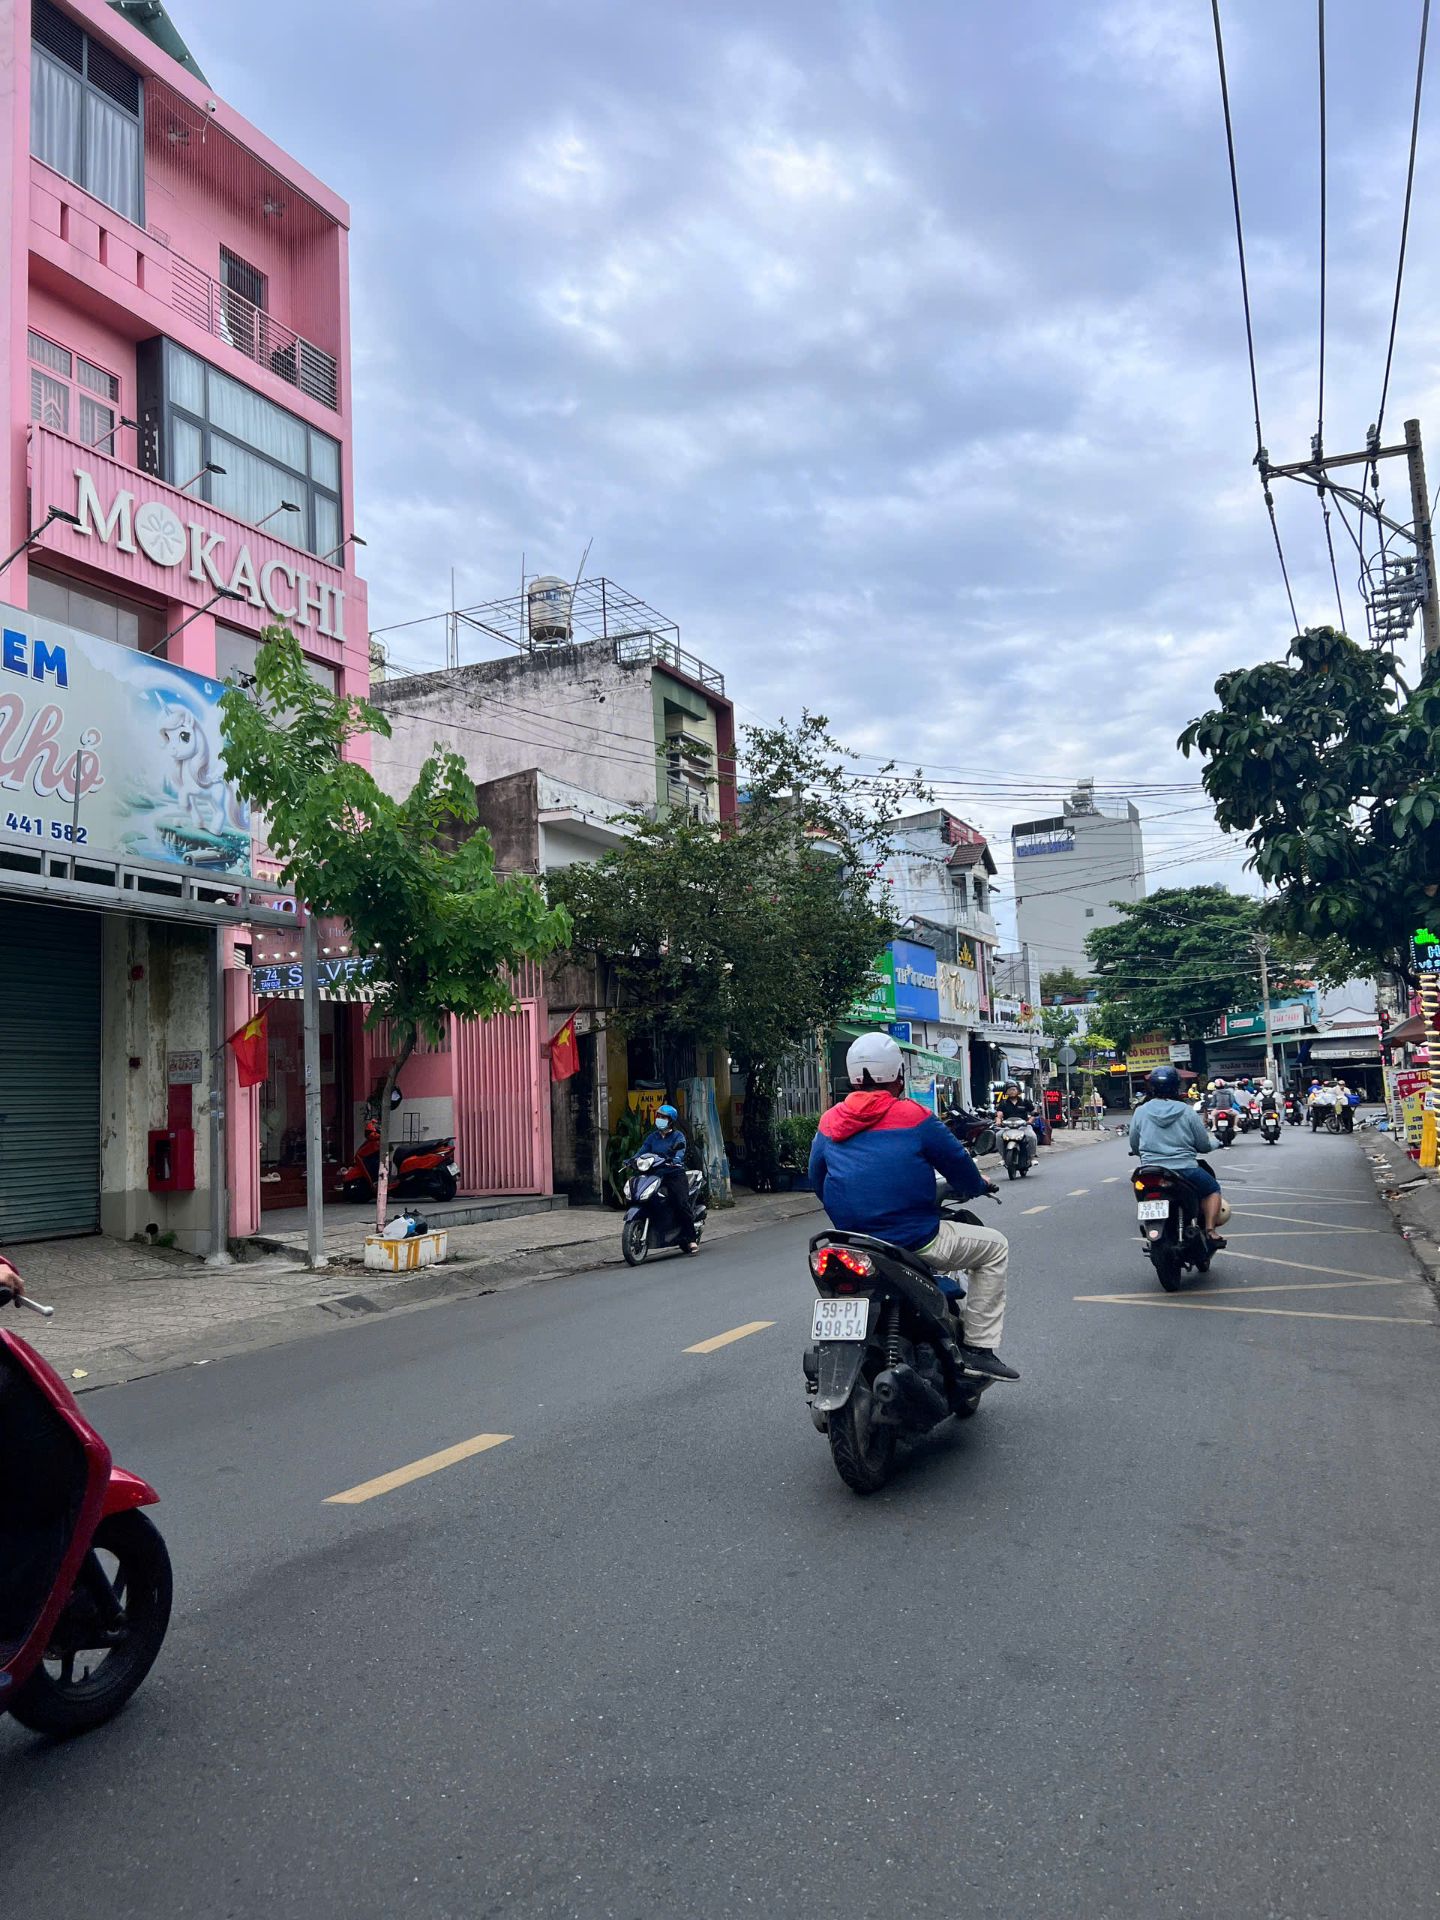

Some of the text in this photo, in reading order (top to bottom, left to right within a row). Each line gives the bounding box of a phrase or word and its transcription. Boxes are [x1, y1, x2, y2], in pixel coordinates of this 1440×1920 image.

[73, 468, 346, 642] MOKACHI
[2, 628, 69, 688] EM
[6, 813, 88, 844] 441 582
[265, 970, 278, 980] 74
[822, 1302, 859, 1318] 59-P1
[815, 1320, 862, 1337] 998.54
